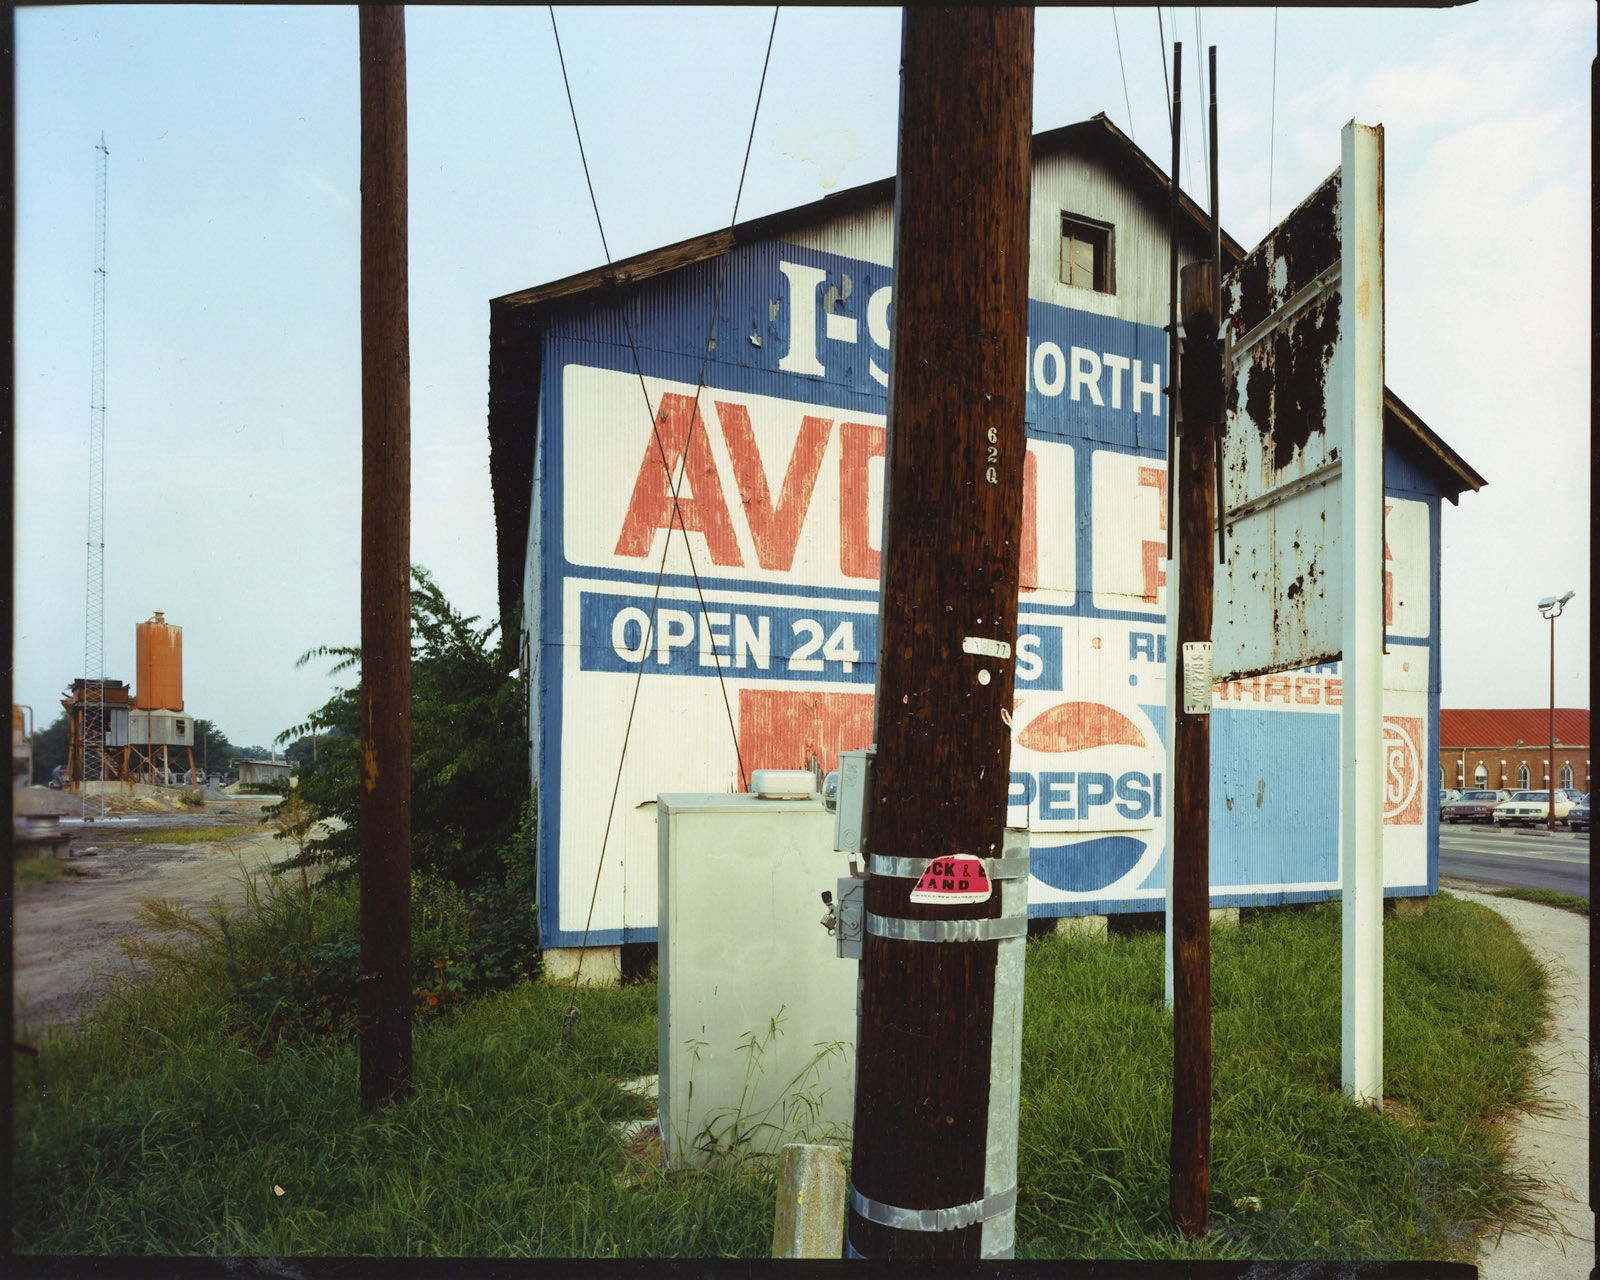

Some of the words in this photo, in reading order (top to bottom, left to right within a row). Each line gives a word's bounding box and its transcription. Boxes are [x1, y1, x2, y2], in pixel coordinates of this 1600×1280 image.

[1026, 337, 1161, 416] ORTH
[612, 607, 770, 670] OPEN
[788, 619, 860, 673] 24
[1008, 771, 1162, 821] PEPSI
[924, 862, 955, 877] CK
